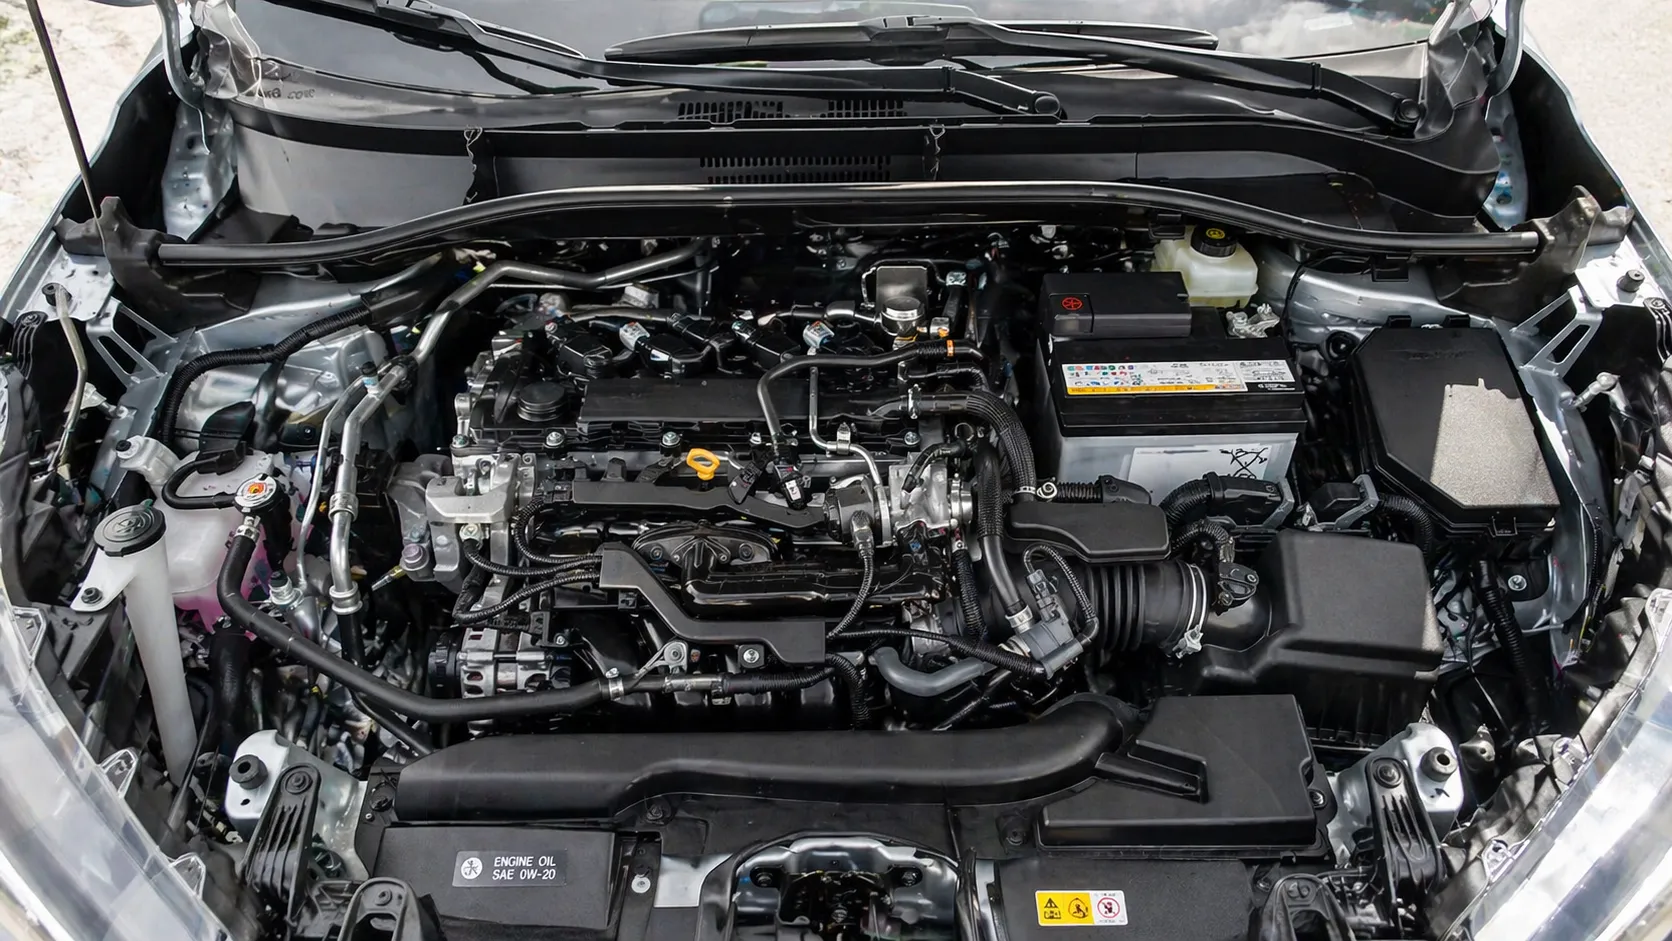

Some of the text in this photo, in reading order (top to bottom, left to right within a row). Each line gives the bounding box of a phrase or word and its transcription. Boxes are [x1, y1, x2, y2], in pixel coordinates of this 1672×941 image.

[493, 855, 557, 867] ENGINE OIL
[492, 868, 557, 881] SAE 0W-20
